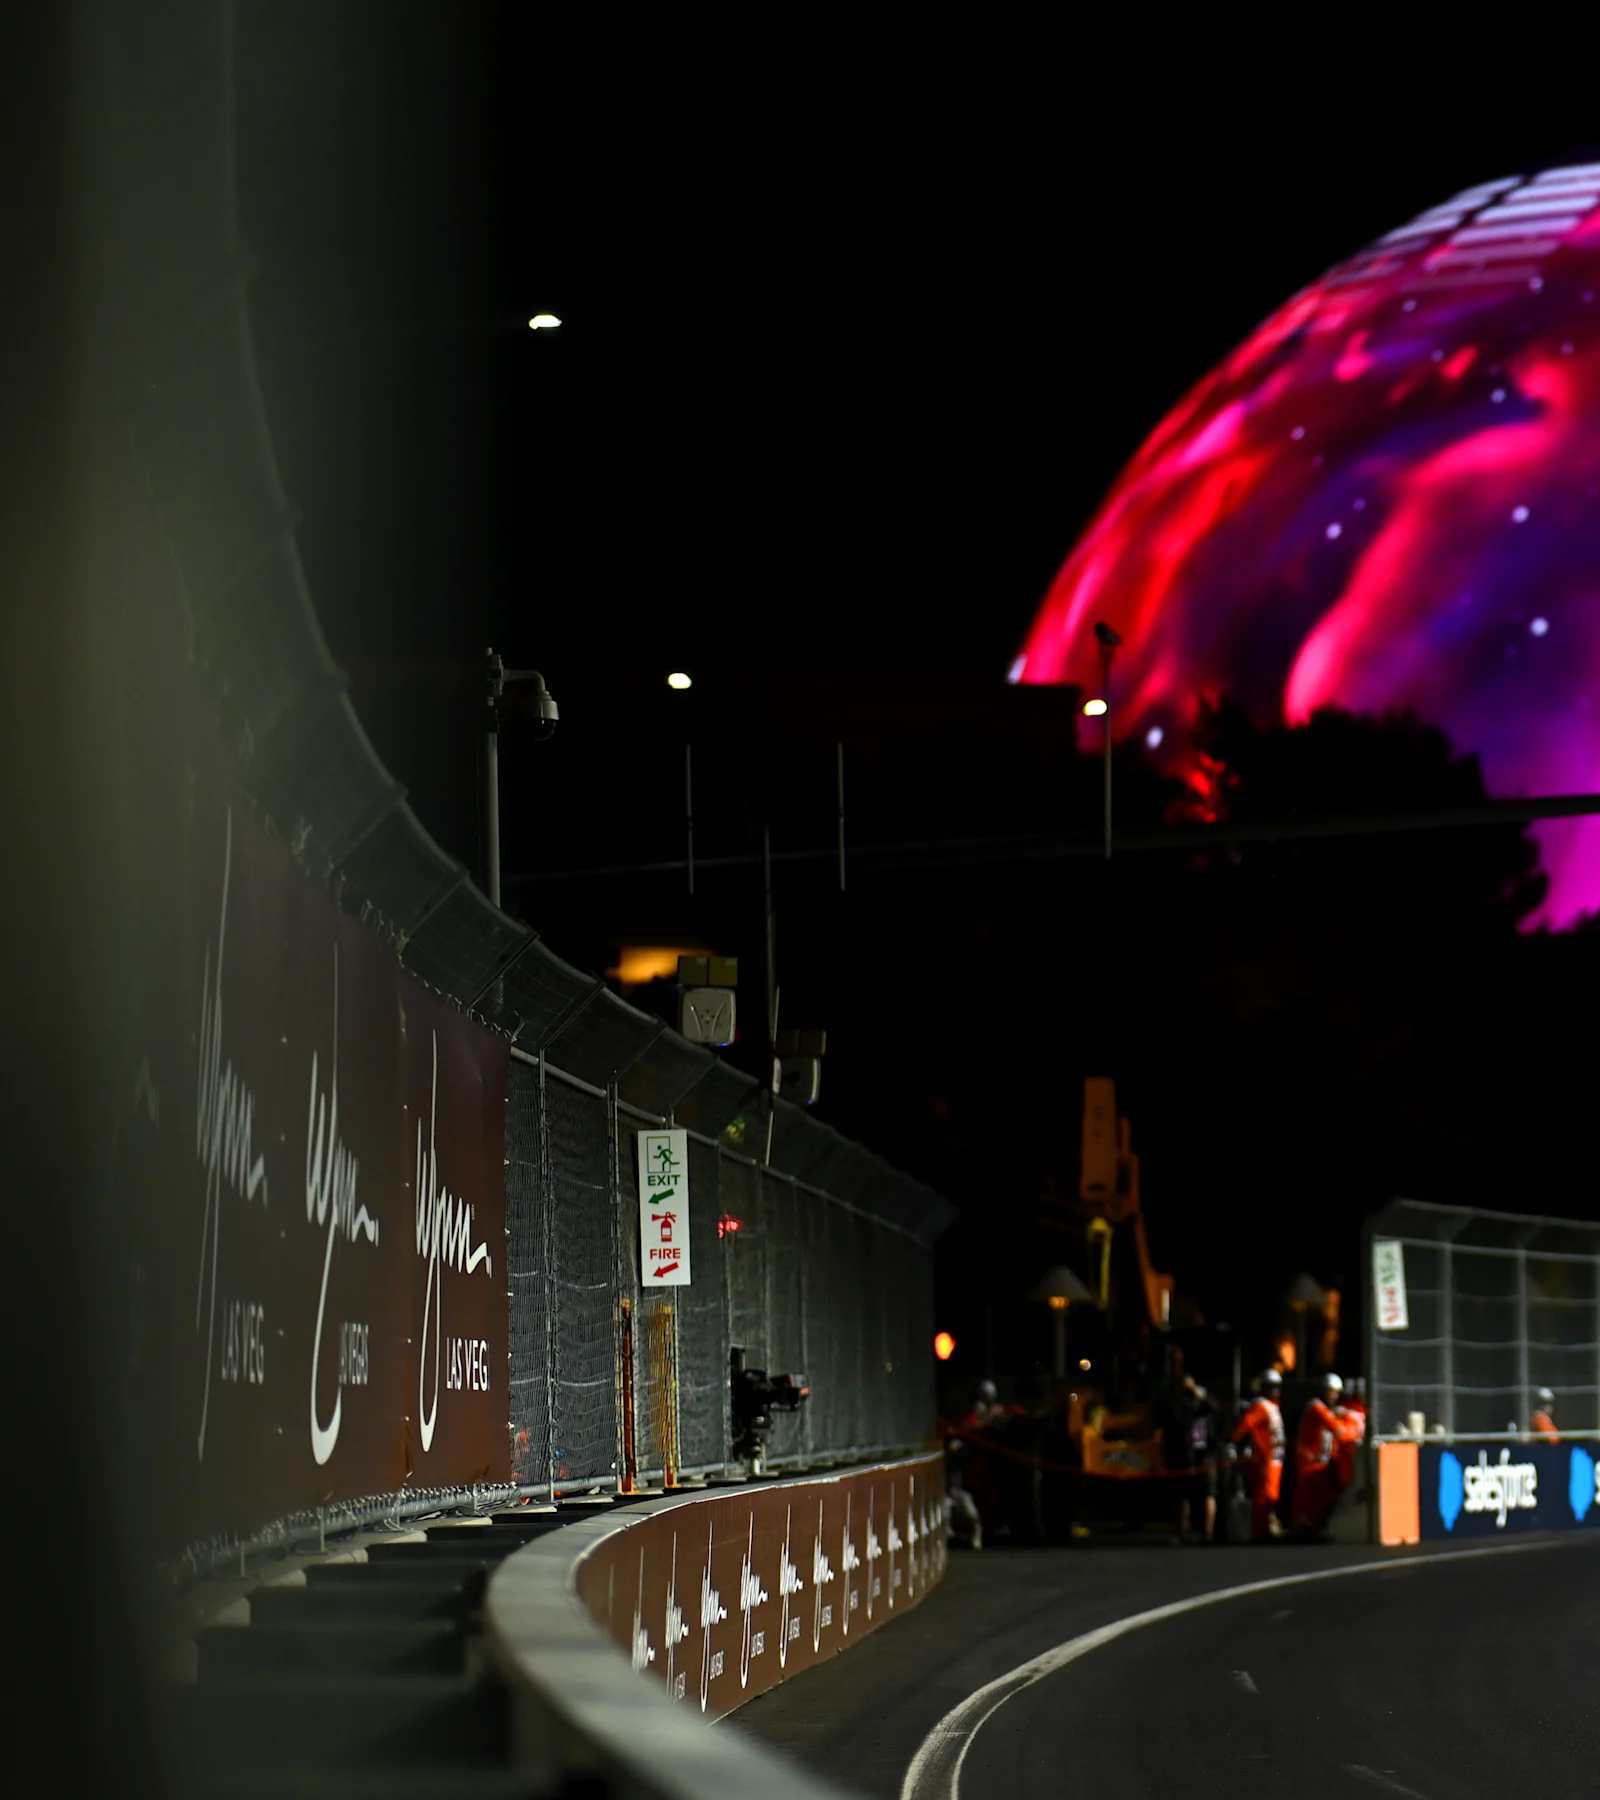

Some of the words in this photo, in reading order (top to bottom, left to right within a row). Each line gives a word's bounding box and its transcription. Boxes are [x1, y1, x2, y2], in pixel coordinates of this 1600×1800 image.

[648, 1174, 681, 1186] EXIT
[650, 1248, 681, 1260] FIRE
[446, 1336, 463, 1391] LAS
[464, 1338, 490, 1392] VEG
[1464, 1448, 1537, 1528] salesforce
